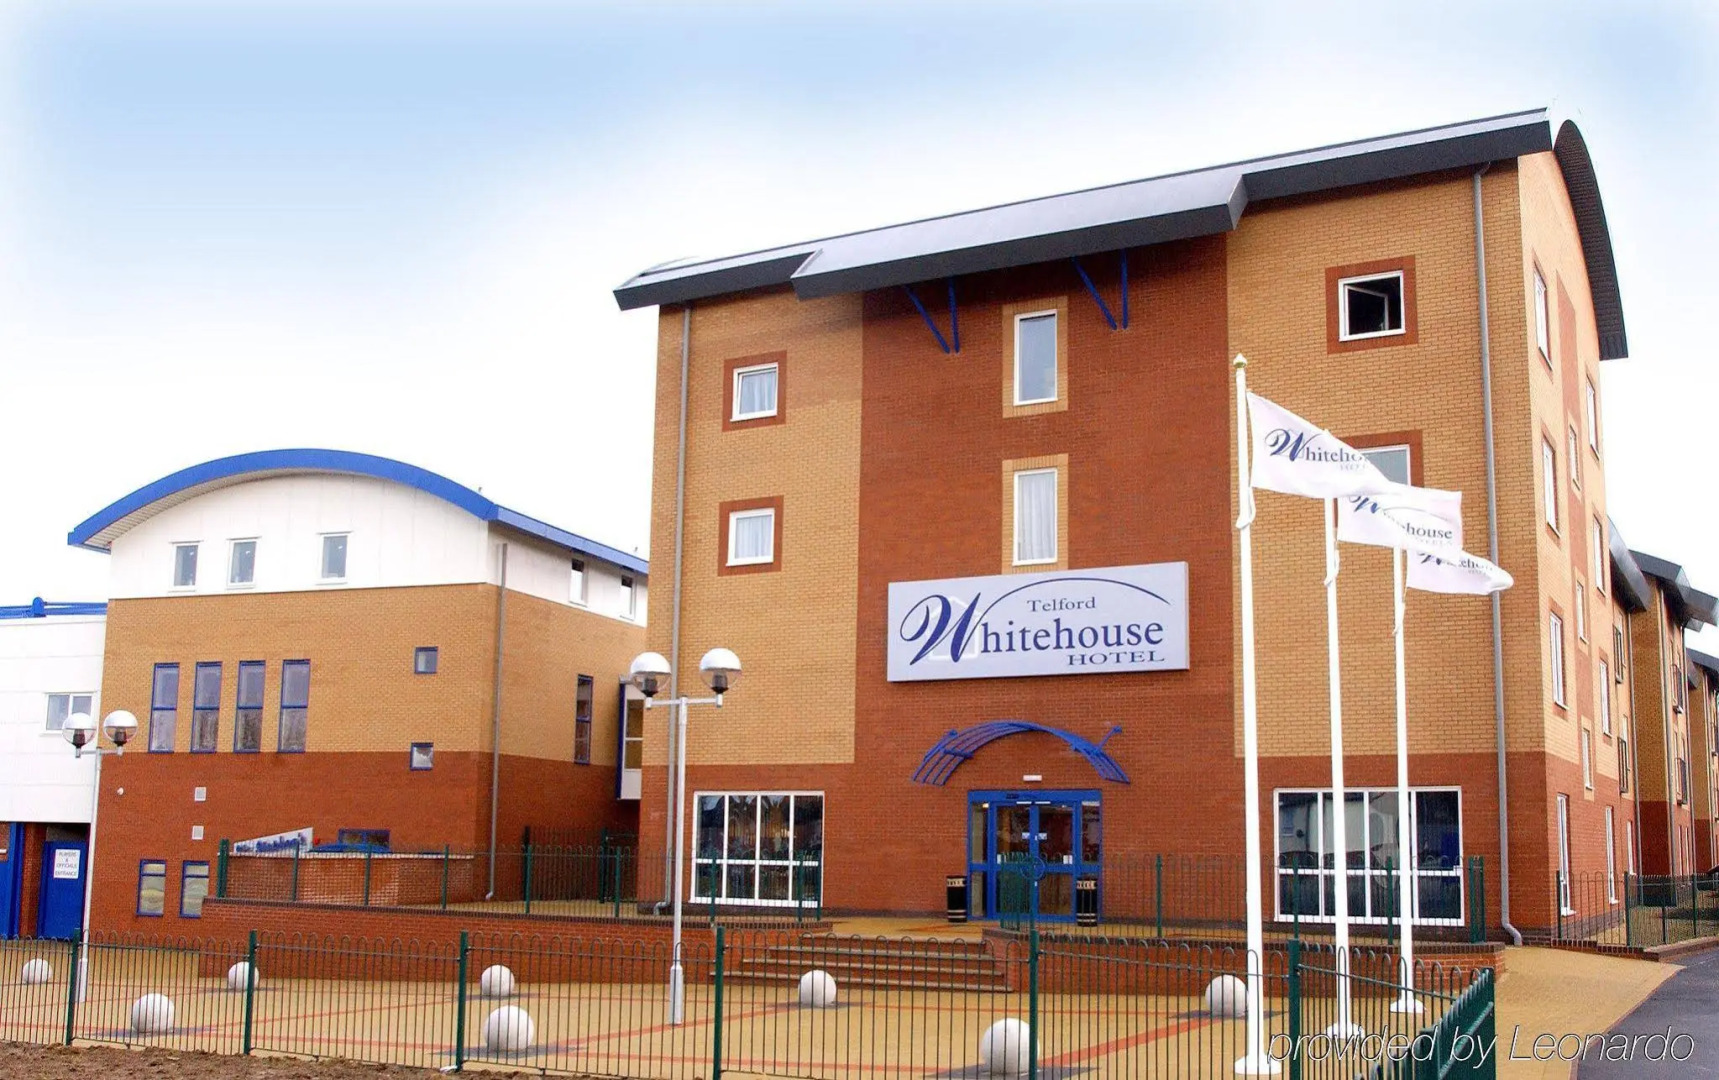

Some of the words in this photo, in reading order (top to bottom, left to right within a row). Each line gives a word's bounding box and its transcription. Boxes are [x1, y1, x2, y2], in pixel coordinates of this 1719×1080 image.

[1265, 428, 1363, 463] Whiteho
[1027, 596, 1096, 613] Telford
[899, 591, 1164, 666] Whitehouse
[1067, 649, 1166, 666] HOTEL
